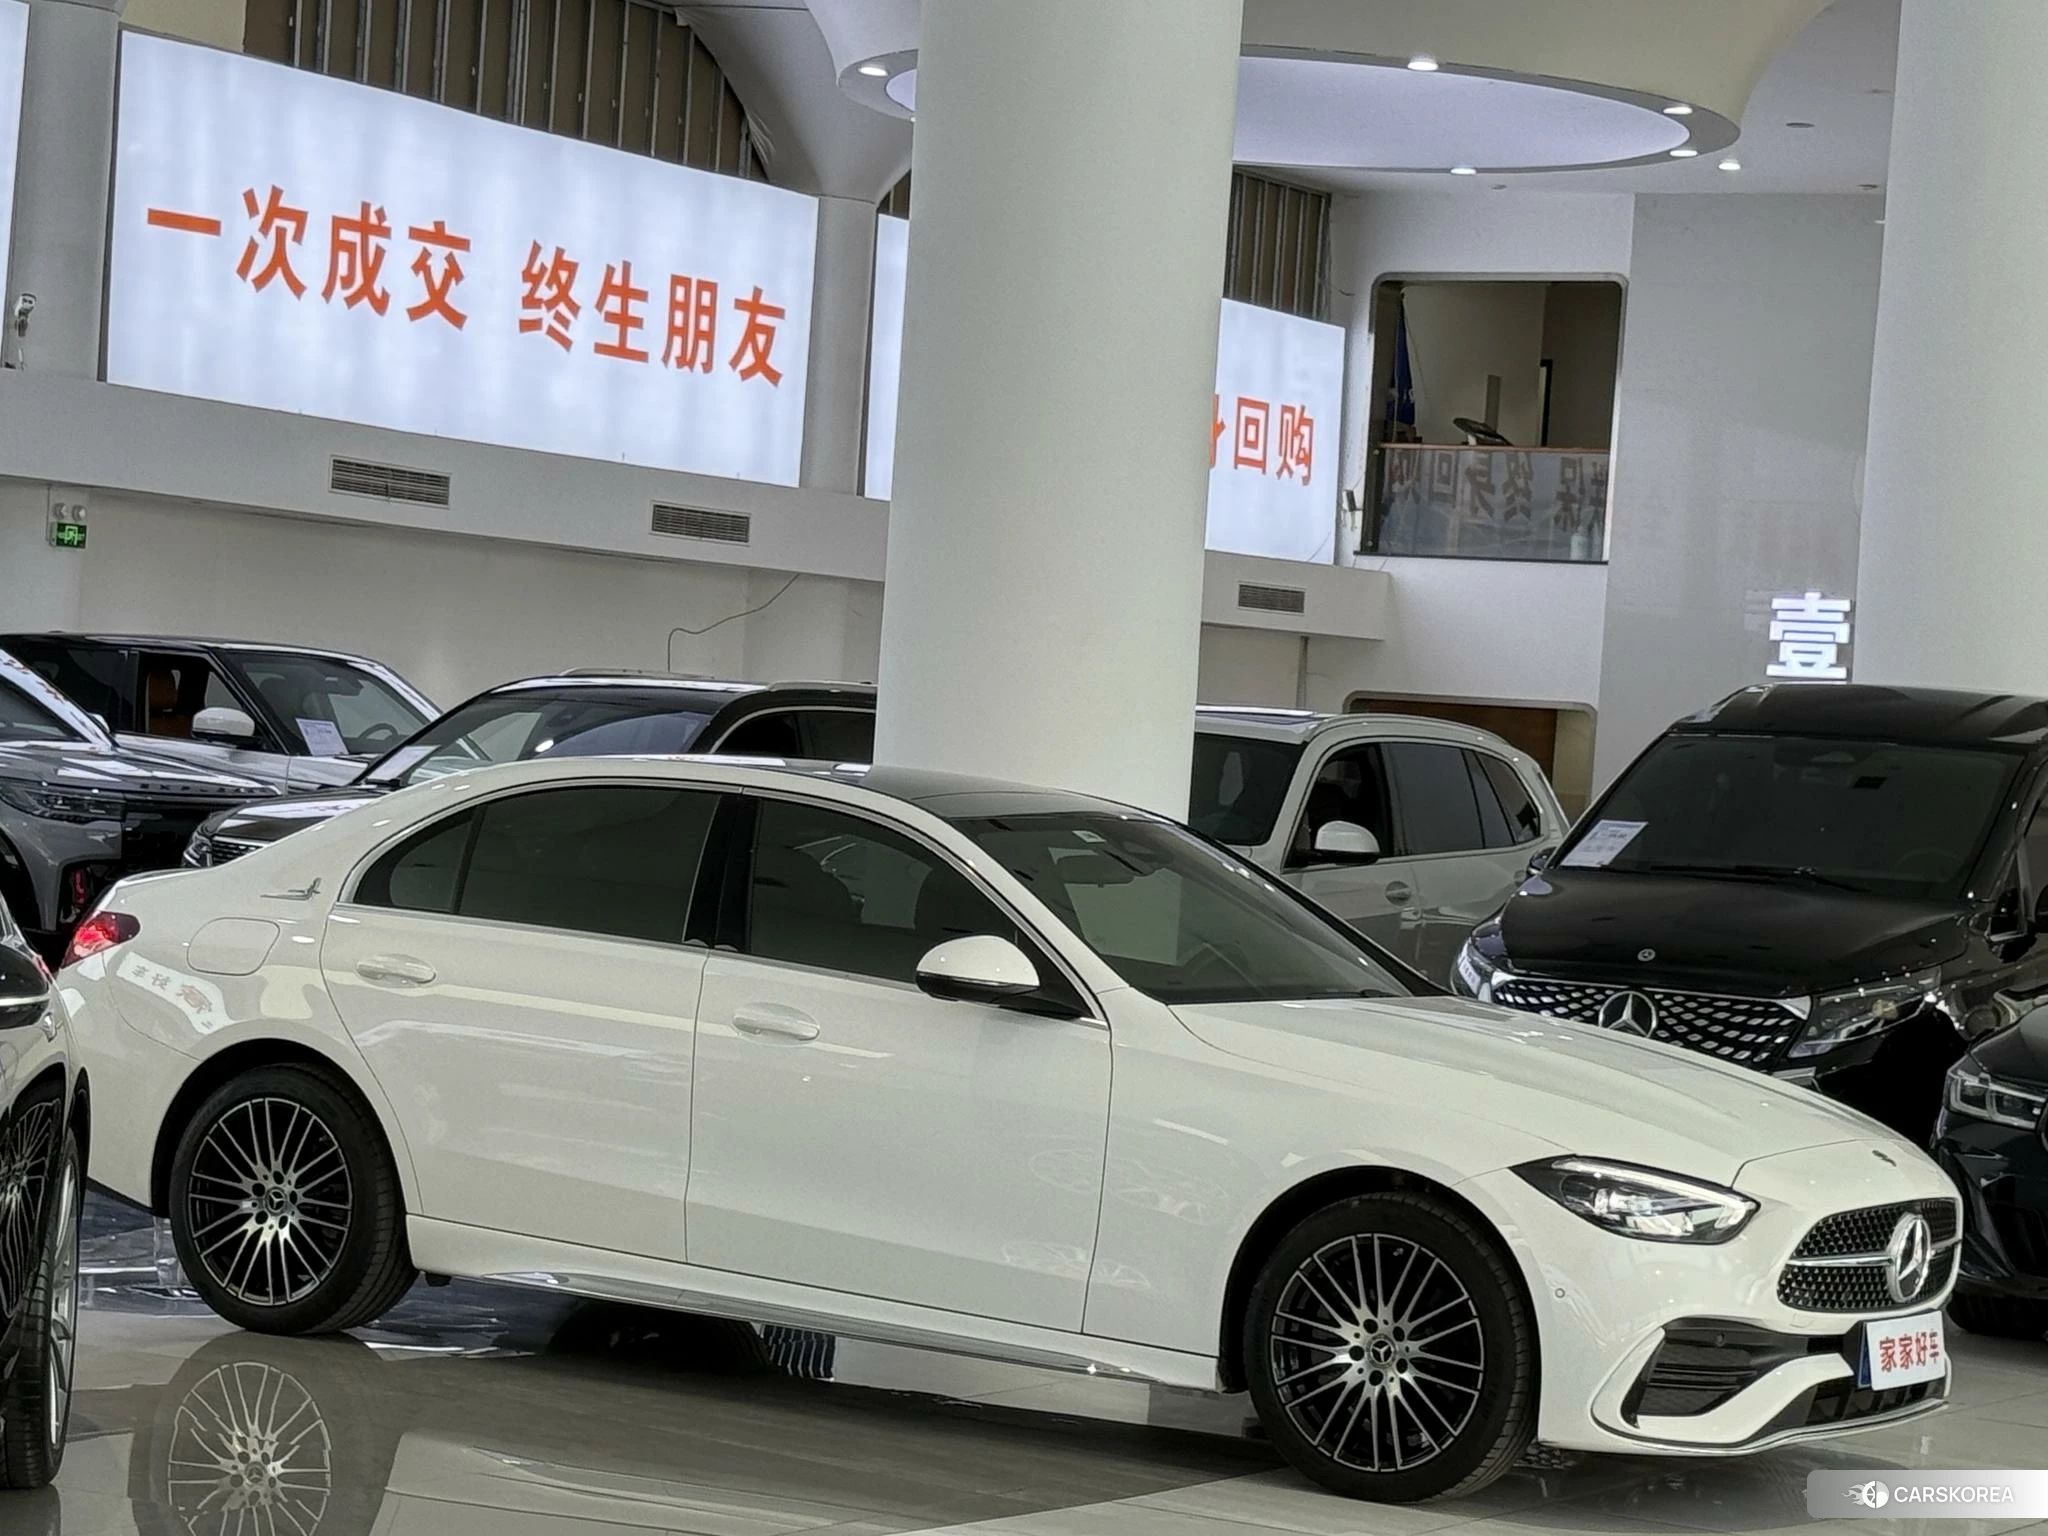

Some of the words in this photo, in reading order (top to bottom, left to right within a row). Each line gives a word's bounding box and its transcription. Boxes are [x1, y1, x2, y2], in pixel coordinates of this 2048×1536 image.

[147, 186, 470, 328] 一次成交
[519, 241, 785, 386] 终生朋友
[1208, 394, 1315, 487] 回购
[1766, 592, 1851, 679] 壹
[1878, 1329, 1940, 1373] 家家好车
